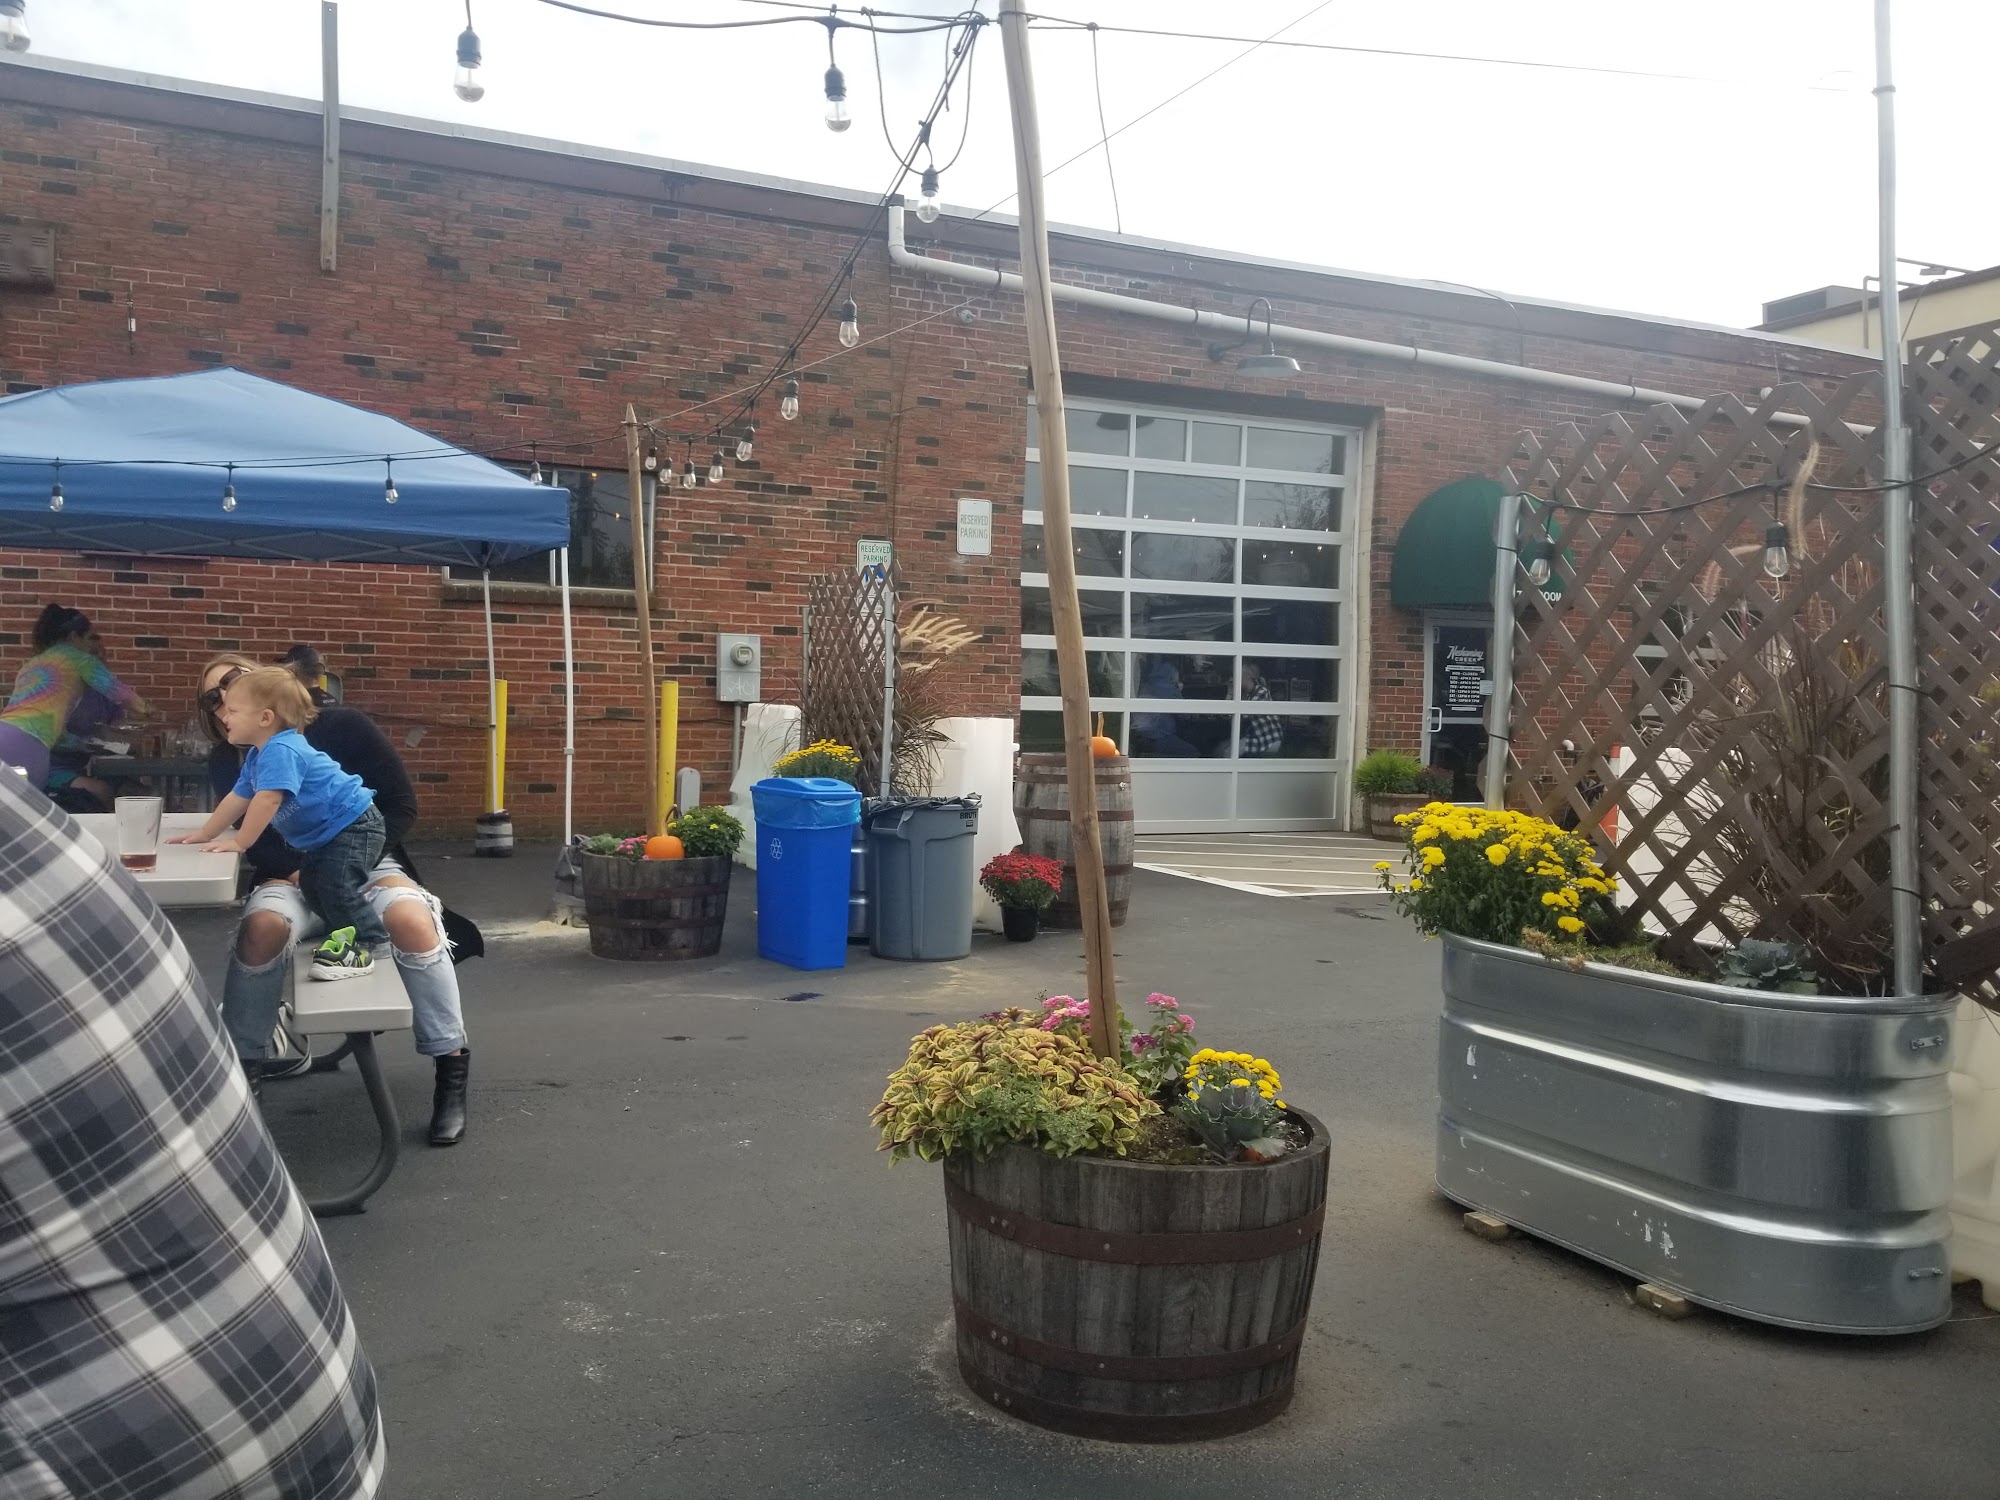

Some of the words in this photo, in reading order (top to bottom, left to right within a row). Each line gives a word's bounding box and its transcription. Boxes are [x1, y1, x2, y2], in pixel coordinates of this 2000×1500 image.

[960, 514, 989, 526] RESERVED
[960, 527, 988, 539] PARKING
[860, 544, 891, 554] RESERVED
[863, 554, 888, 563] PARKING
